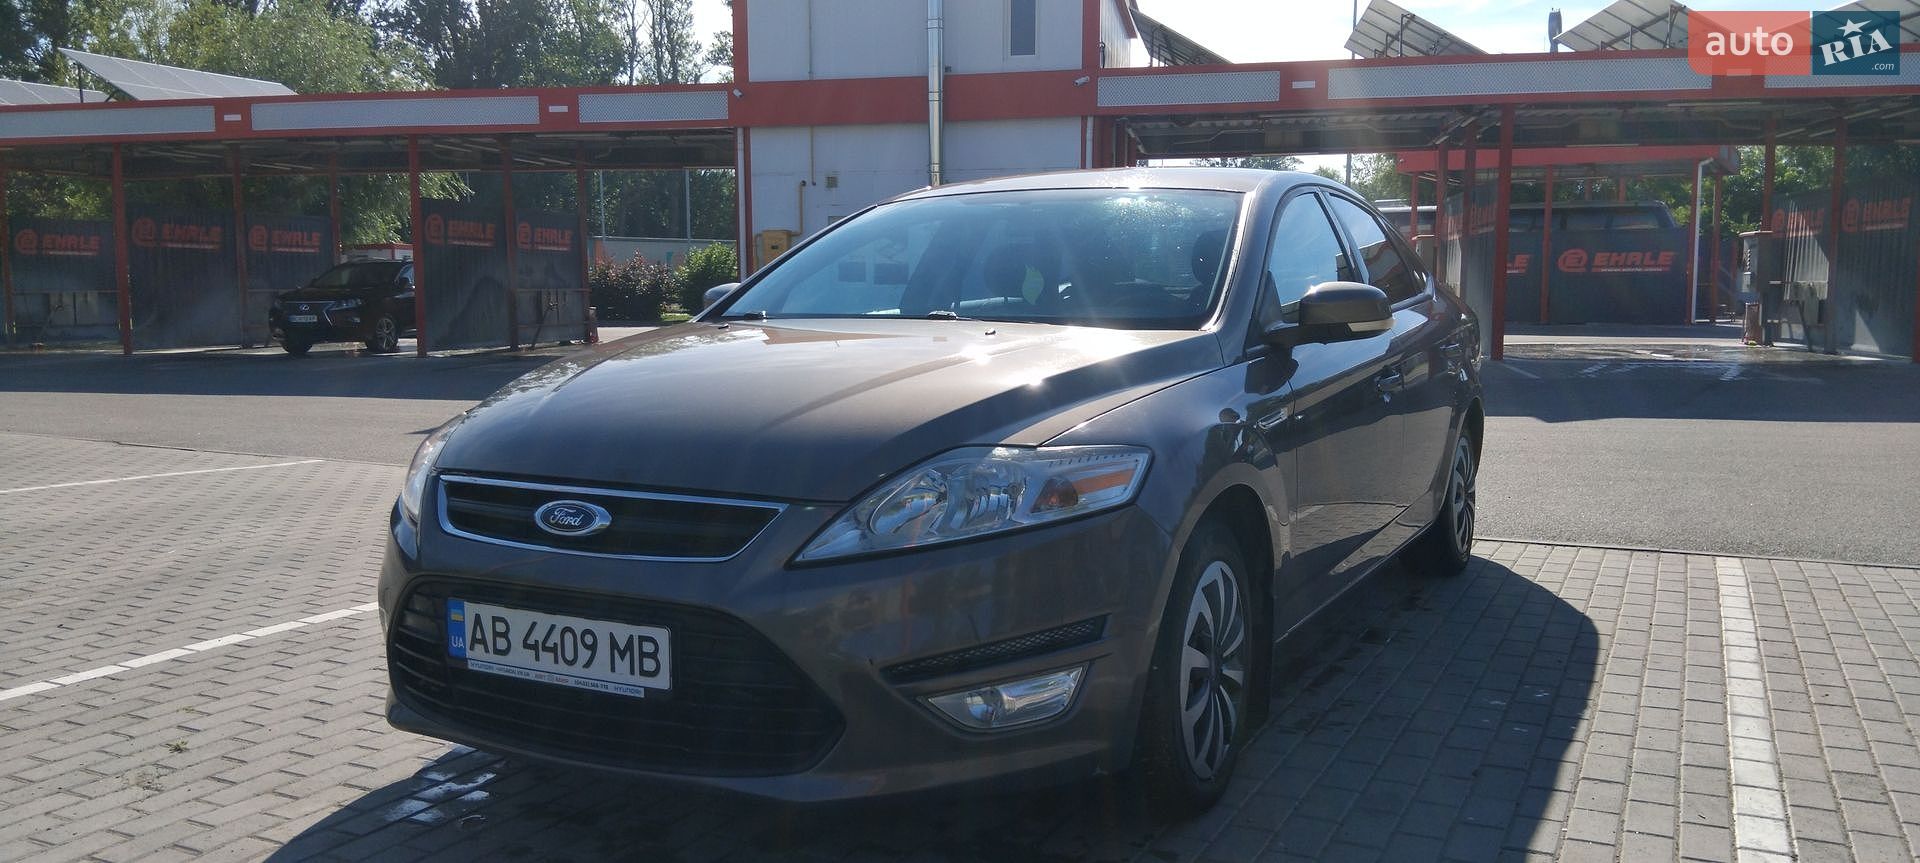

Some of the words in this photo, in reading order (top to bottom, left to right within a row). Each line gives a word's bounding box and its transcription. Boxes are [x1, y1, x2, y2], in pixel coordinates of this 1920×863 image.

[1595, 251, 1677, 266] EHRLE
[550, 507, 584, 526] Ford
[452, 635, 465, 649] UA
[469, 613, 512, 657] AB
[522, 621, 598, 669] 4409
[609, 631, 661, 678] MB
